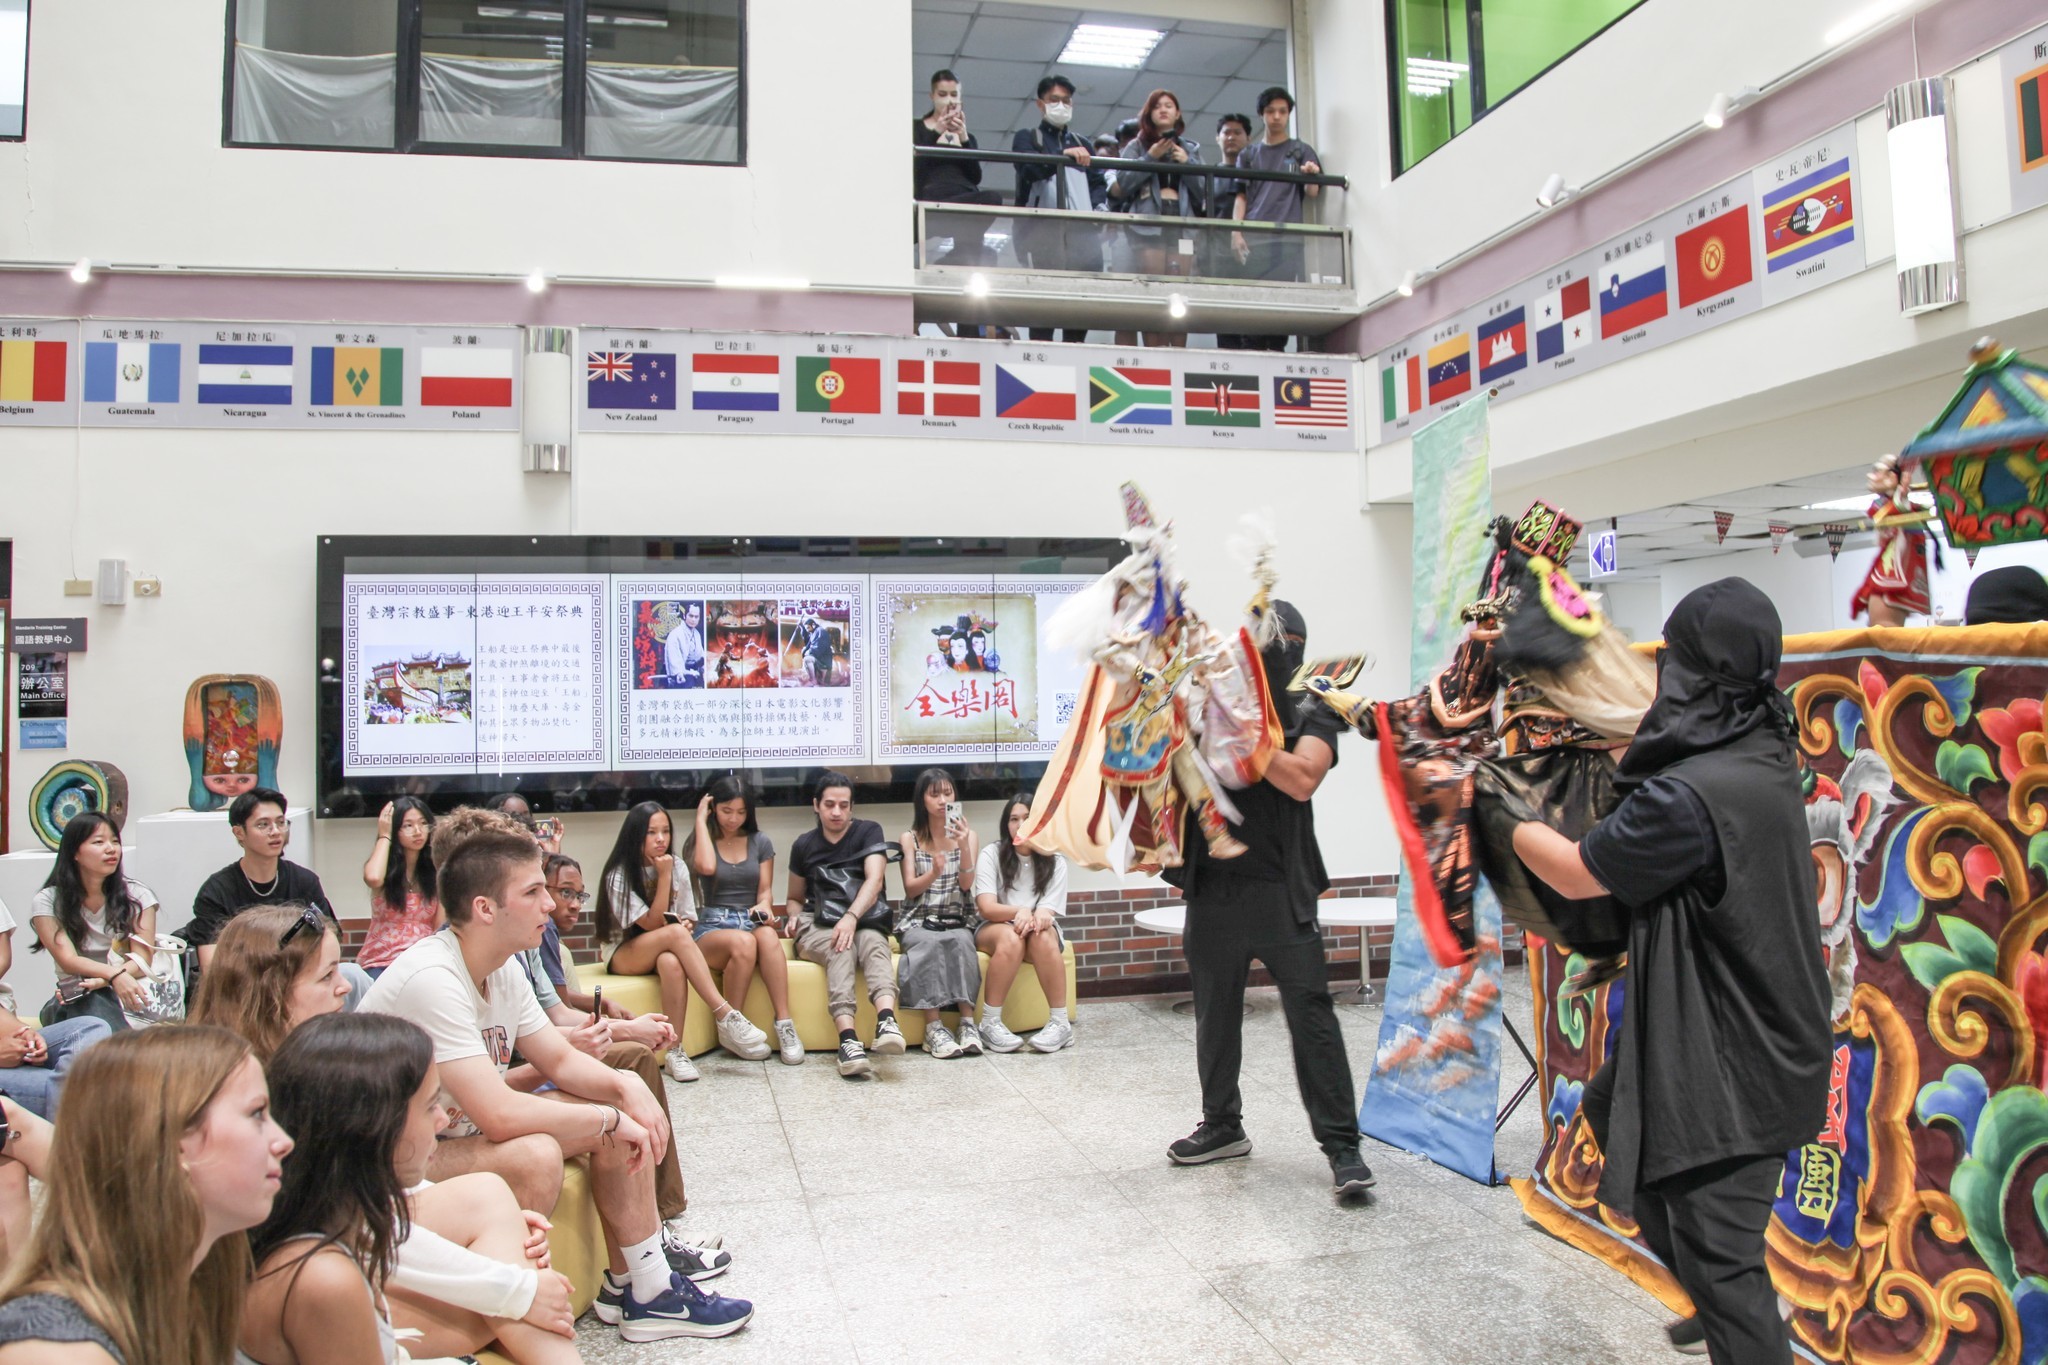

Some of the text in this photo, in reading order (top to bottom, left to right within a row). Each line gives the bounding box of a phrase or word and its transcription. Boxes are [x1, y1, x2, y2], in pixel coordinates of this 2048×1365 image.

[1776, 147, 1829, 182] 史瓦帝尼
[1686, 194, 1731, 226] 吉爾吉斯
[1796, 259, 1826, 279] Swatini
[1696, 296, 1735, 317] Kyrgyzstan
[102, 329, 161, 340] 瓜地馬拉
[216, 331, 273, 342] 尼加拉瓜
[335, 333, 376, 343] 聖文森
[1622, 329, 1647, 344] Slovenia
[452, 335, 478, 345] 波蘭
[610, 339, 649, 349] 紐西蘭
[714, 341, 753, 351] 巴拉圭
[817, 343, 854, 354] 葡萄牙
[1023, 352, 1045, 362] 捷克
[1554, 356, 1575, 369] Panama
[1286, 365, 1330, 376] 馬來西亞
[108, 406, 155, 415] Guatemala
[223, 408, 267, 418] Nicaragua
[367, 411, 406, 419] Grenadines
[452, 410, 480, 419] Poland
[605, 413, 658, 421] New Zealand
[717, 414, 754, 424] Paraguay
[821, 416, 854, 425] Portugal
[922, 419, 957, 427] Denmark
[1008, 422, 1065, 432] Czech Republic
[1109, 426, 1130, 434] South
[1212, 430, 1235, 439] Kenya
[1297, 432, 1327, 441] Malaysia
[15, 635, 73, 645] 國語教學中心
[20, 677, 65, 690] 辦公室
